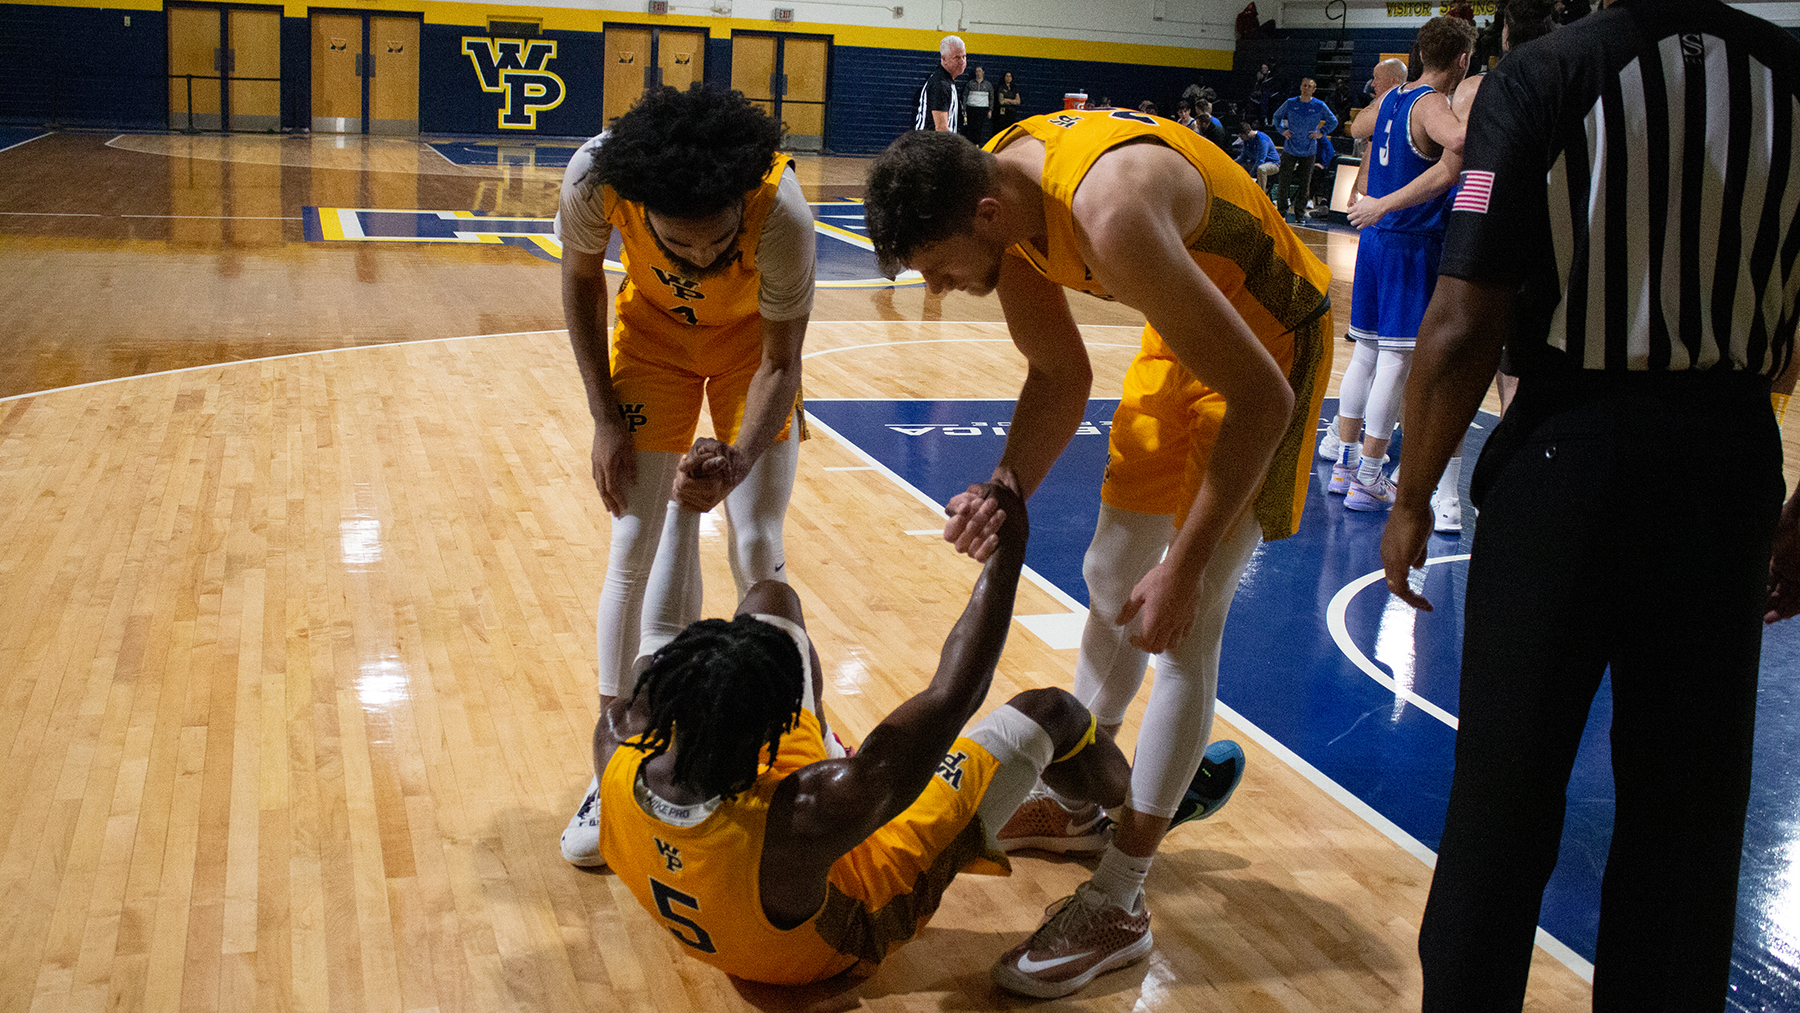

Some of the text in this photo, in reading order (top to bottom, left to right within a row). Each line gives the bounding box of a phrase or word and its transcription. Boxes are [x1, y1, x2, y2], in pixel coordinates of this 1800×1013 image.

[1386, 1, 1431, 16] VISITOR
[461, 36, 566, 130] WP
[1379, 119, 1393, 166] 3
[668, 807, 690, 819] PRO
[648, 875, 718, 955] 5
